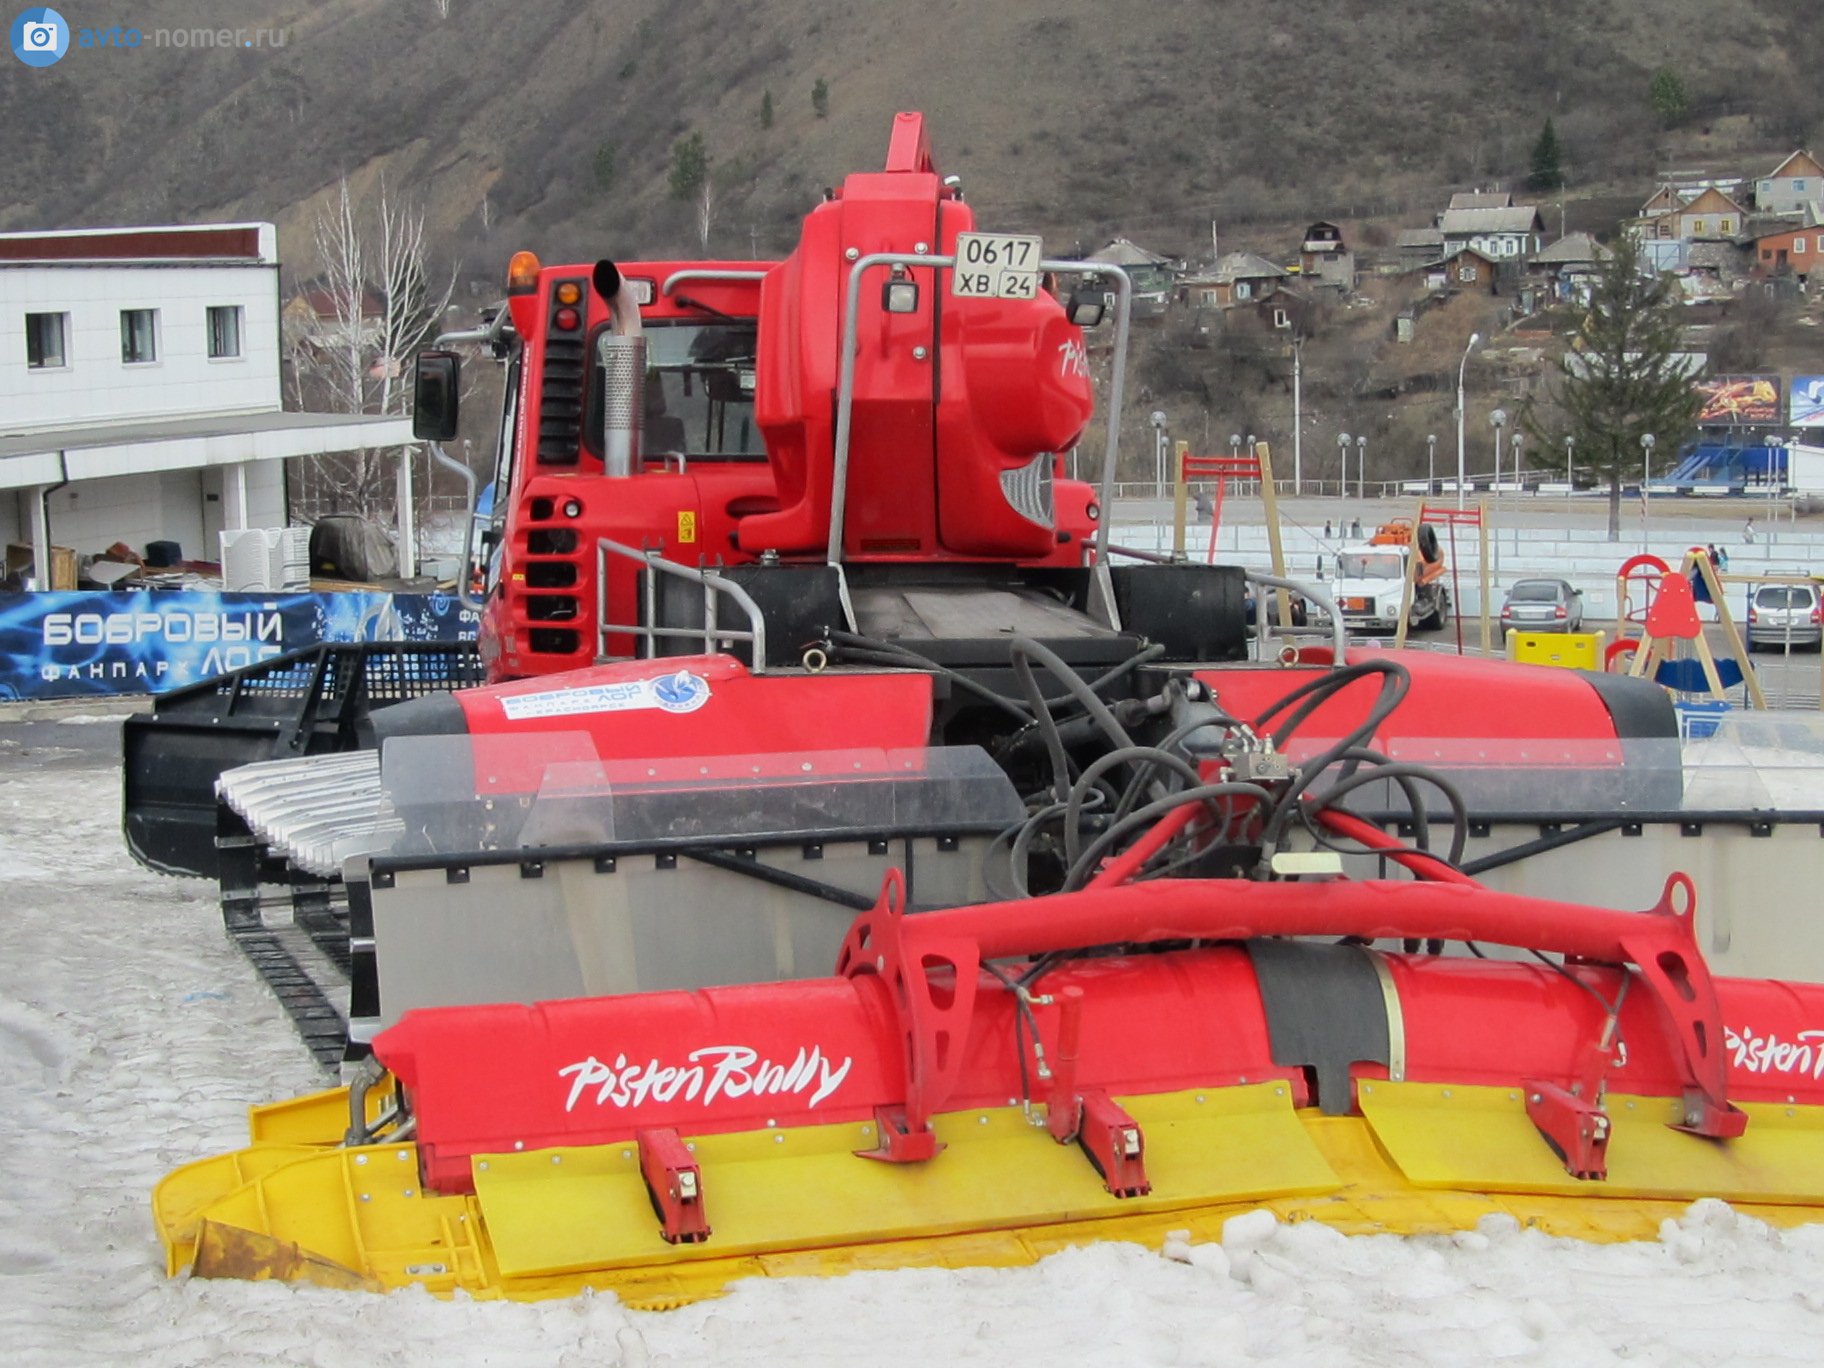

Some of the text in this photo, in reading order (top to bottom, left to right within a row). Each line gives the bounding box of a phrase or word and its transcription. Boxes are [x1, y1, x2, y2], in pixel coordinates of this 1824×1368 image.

[966, 239, 1031, 266] 0617
[959, 273, 1030, 295] ХВ 24
[43, 602, 283, 645] БОБРОВЫЙ
[41, 660, 189, 682] ФАНПАРК
